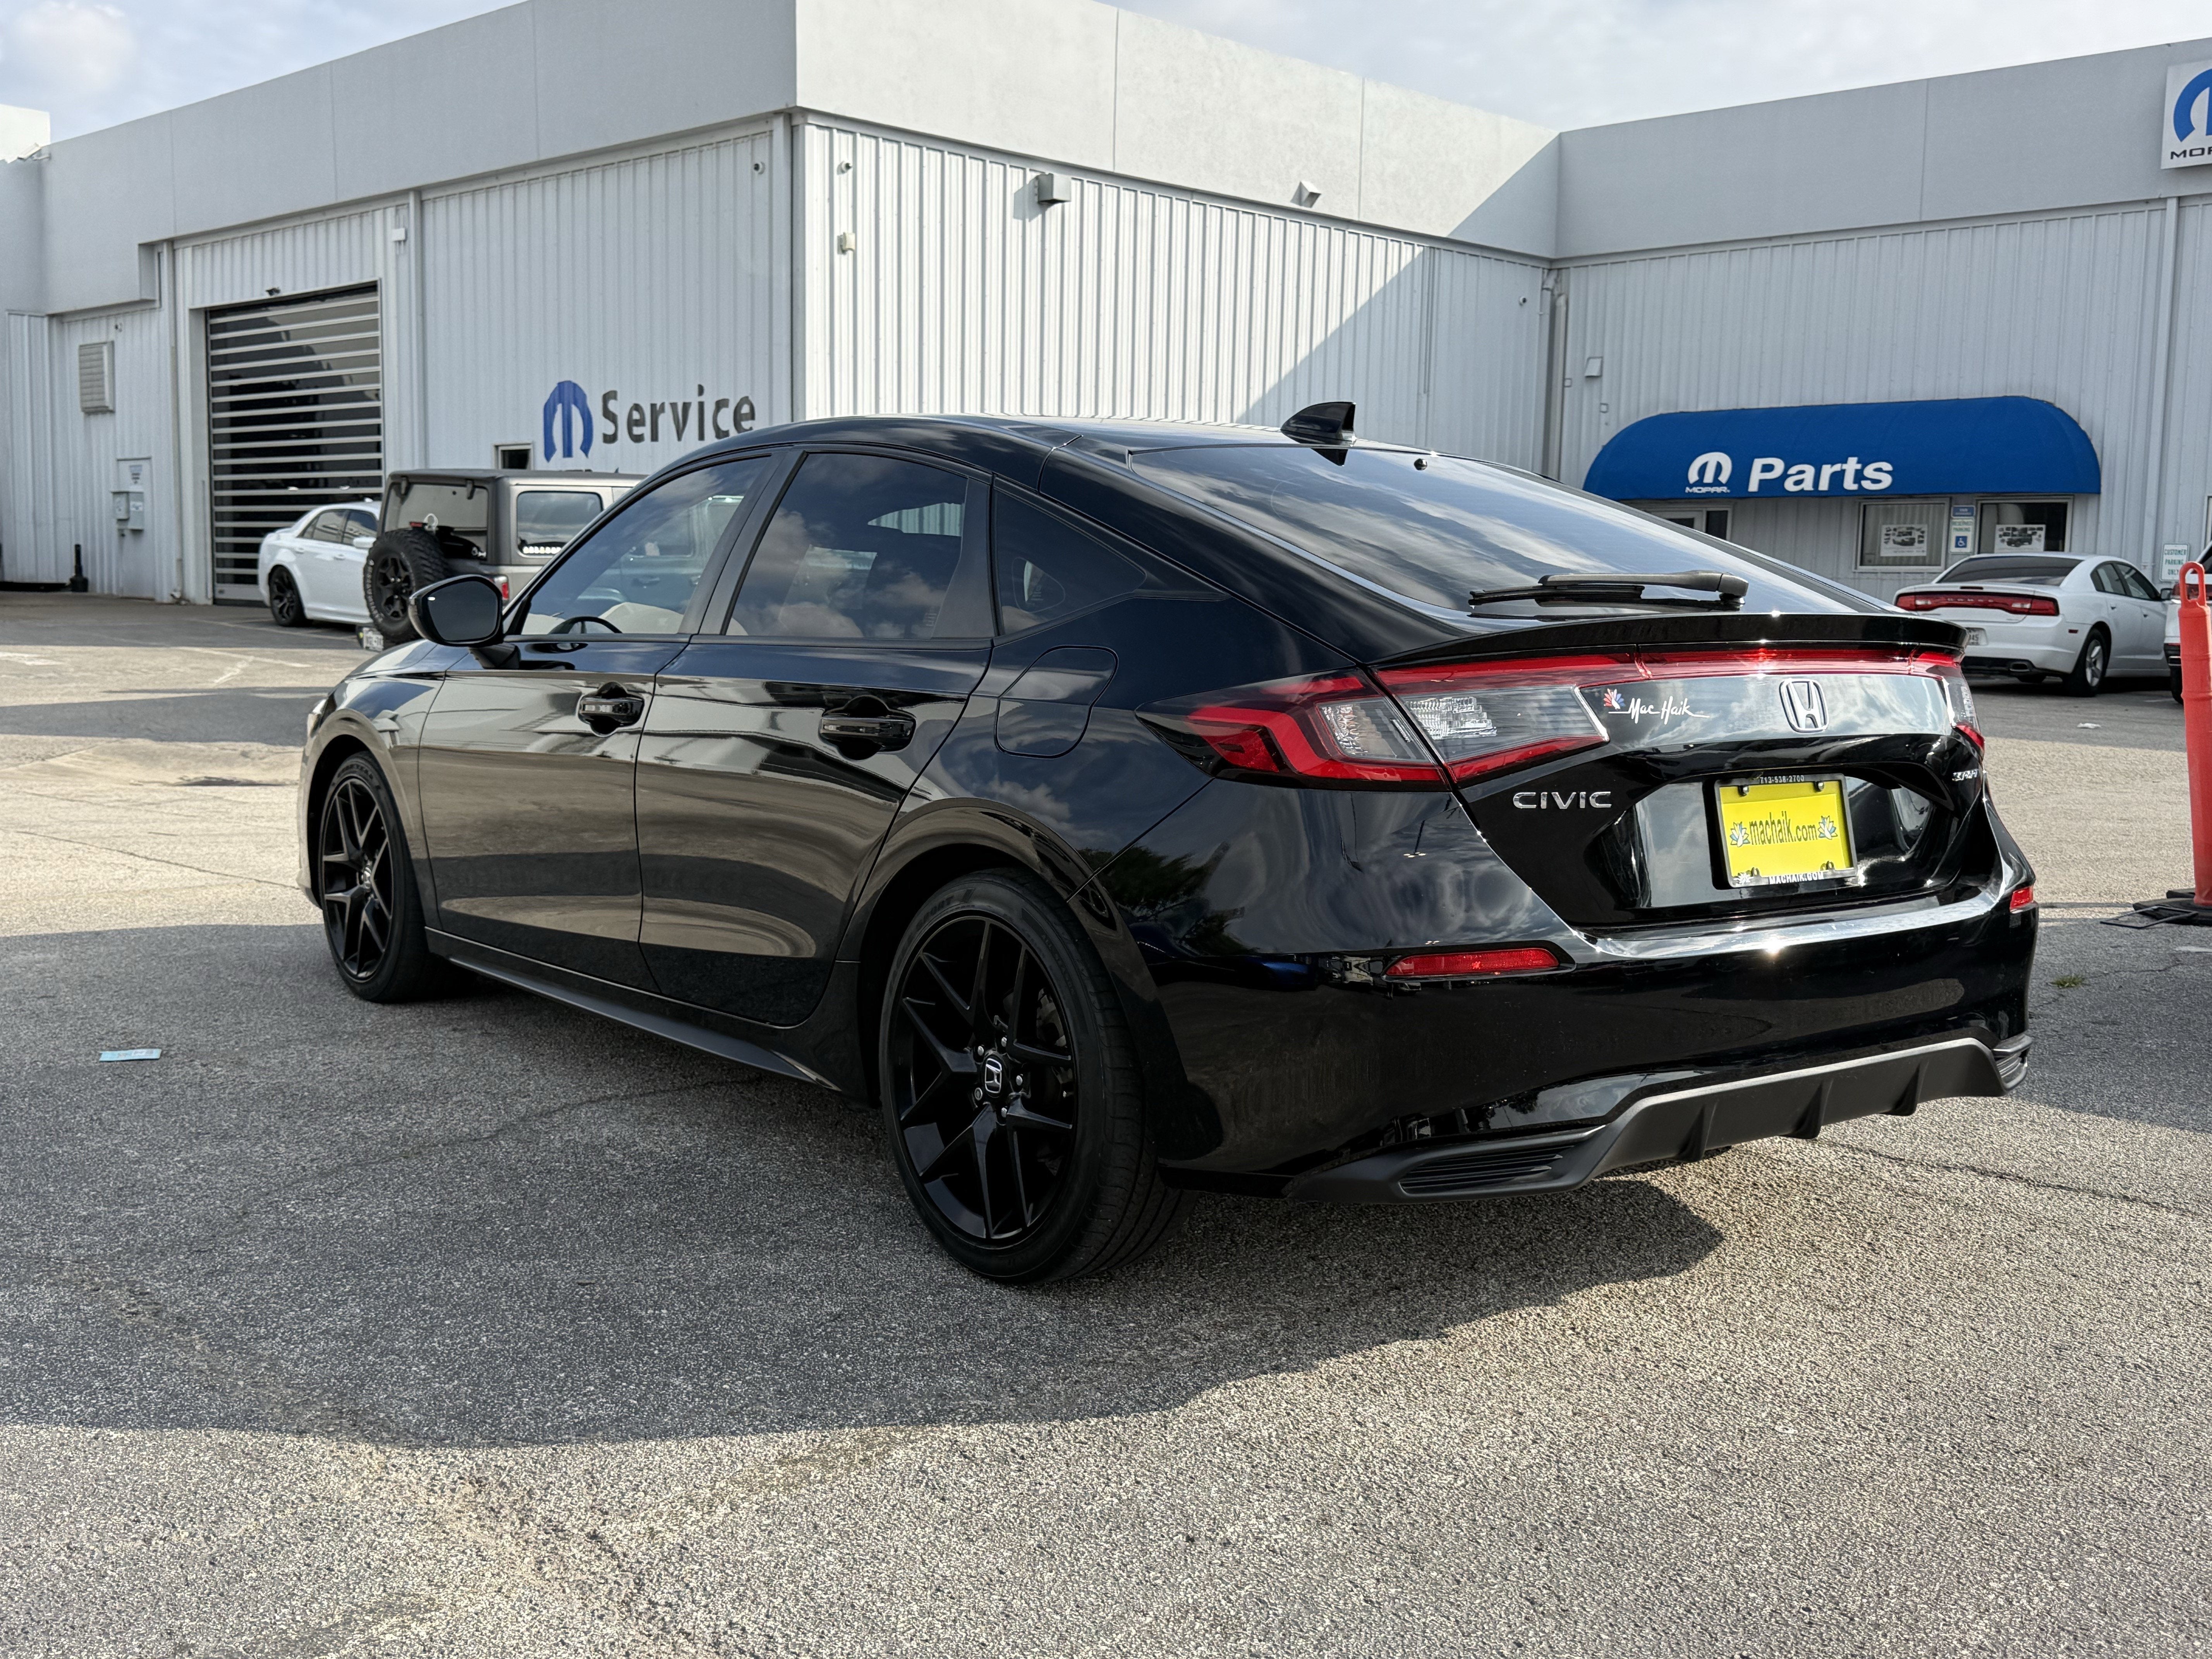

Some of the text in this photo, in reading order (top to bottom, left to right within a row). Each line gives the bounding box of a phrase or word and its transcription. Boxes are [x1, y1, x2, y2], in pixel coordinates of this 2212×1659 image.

[602, 384, 756, 444] Service
[1748, 457, 1893, 492] Parts
[1608, 696, 1710, 725] Mac Haik
[1513, 791, 1612, 809] CIVIC
[1749, 811, 1818, 845] machaik.com
[1768, 872, 1824, 884] MACHAIK.COM
